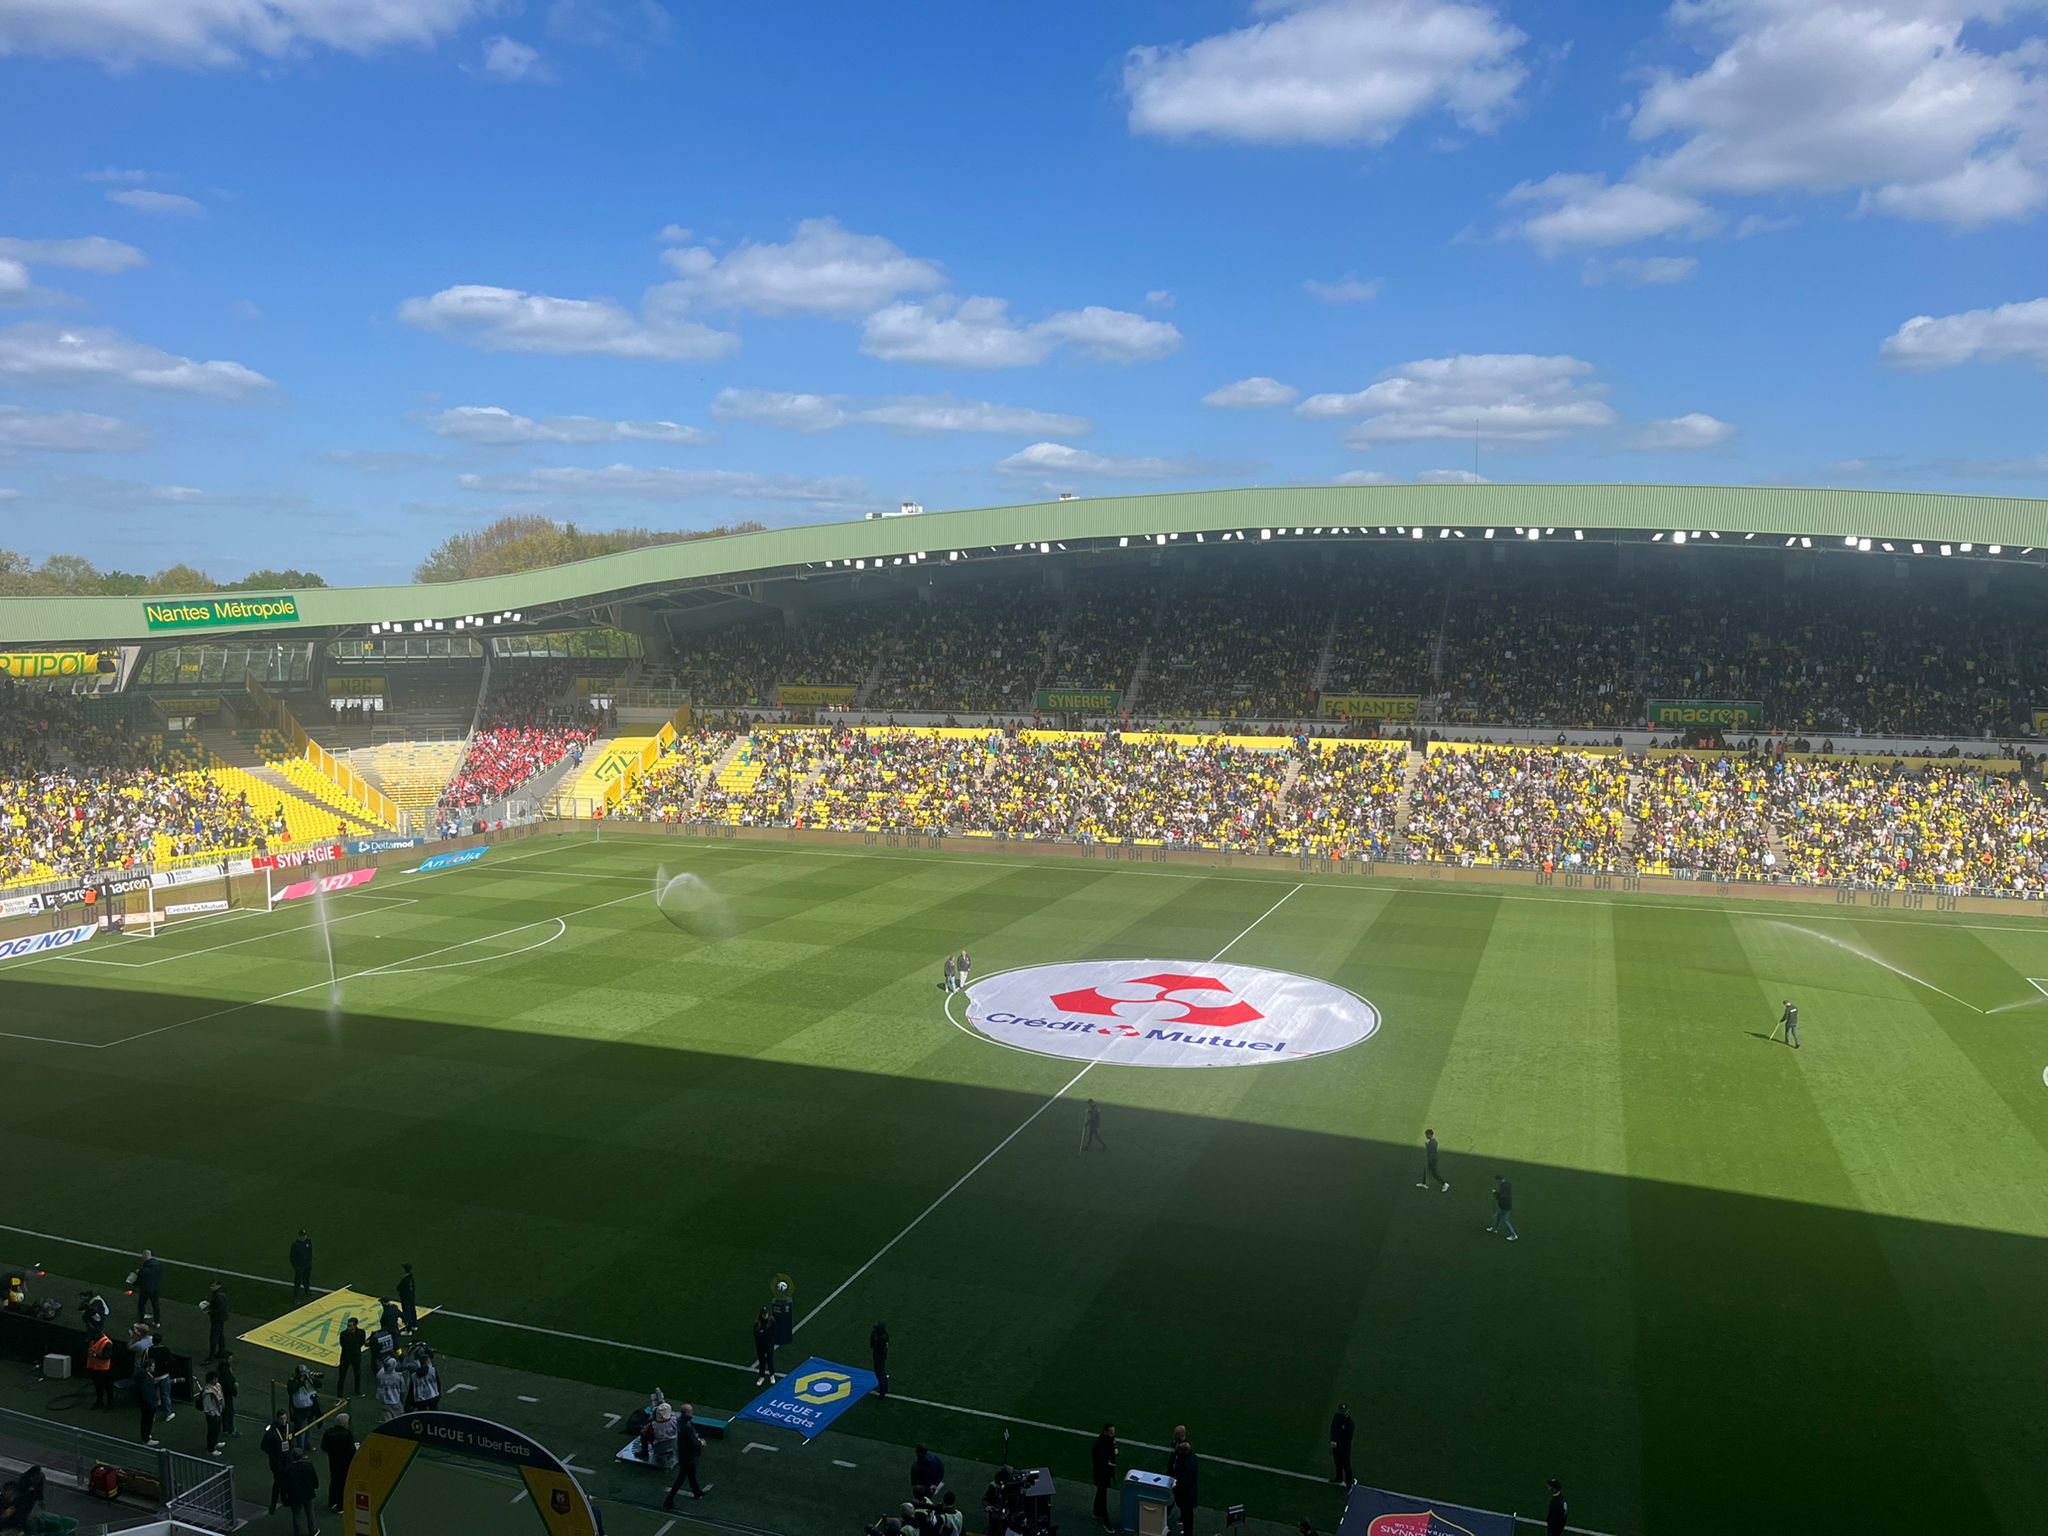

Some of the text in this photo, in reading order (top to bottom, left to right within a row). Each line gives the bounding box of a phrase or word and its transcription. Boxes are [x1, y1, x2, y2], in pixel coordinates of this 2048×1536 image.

[147, 600, 294, 622] Nantes Métropole
[1049, 694, 1111, 709] SYNERGIE
[1325, 701, 1415, 714] FC NANTES
[1660, 708, 1748, 723] macron
[277, 846, 335, 868] SYNERGIE
[1082, 845, 1166, 862] OH OH OH OH
[1300, 858, 1374, 875] OH OH OH OH
[1536, 872, 1640, 891] OH OH OH OH
[1837, 890, 1955, 910] OH OH OH OH
[986, 1013, 1287, 1052] Crédit Mutuel
[266, 1334, 314, 1356] NANTES
[769, 1399, 813, 1416] LIGUE
[757, 1406, 815, 1429] Uber Eats
[427, 1424, 530, 1457] LIGUE 1 Uber Eats
